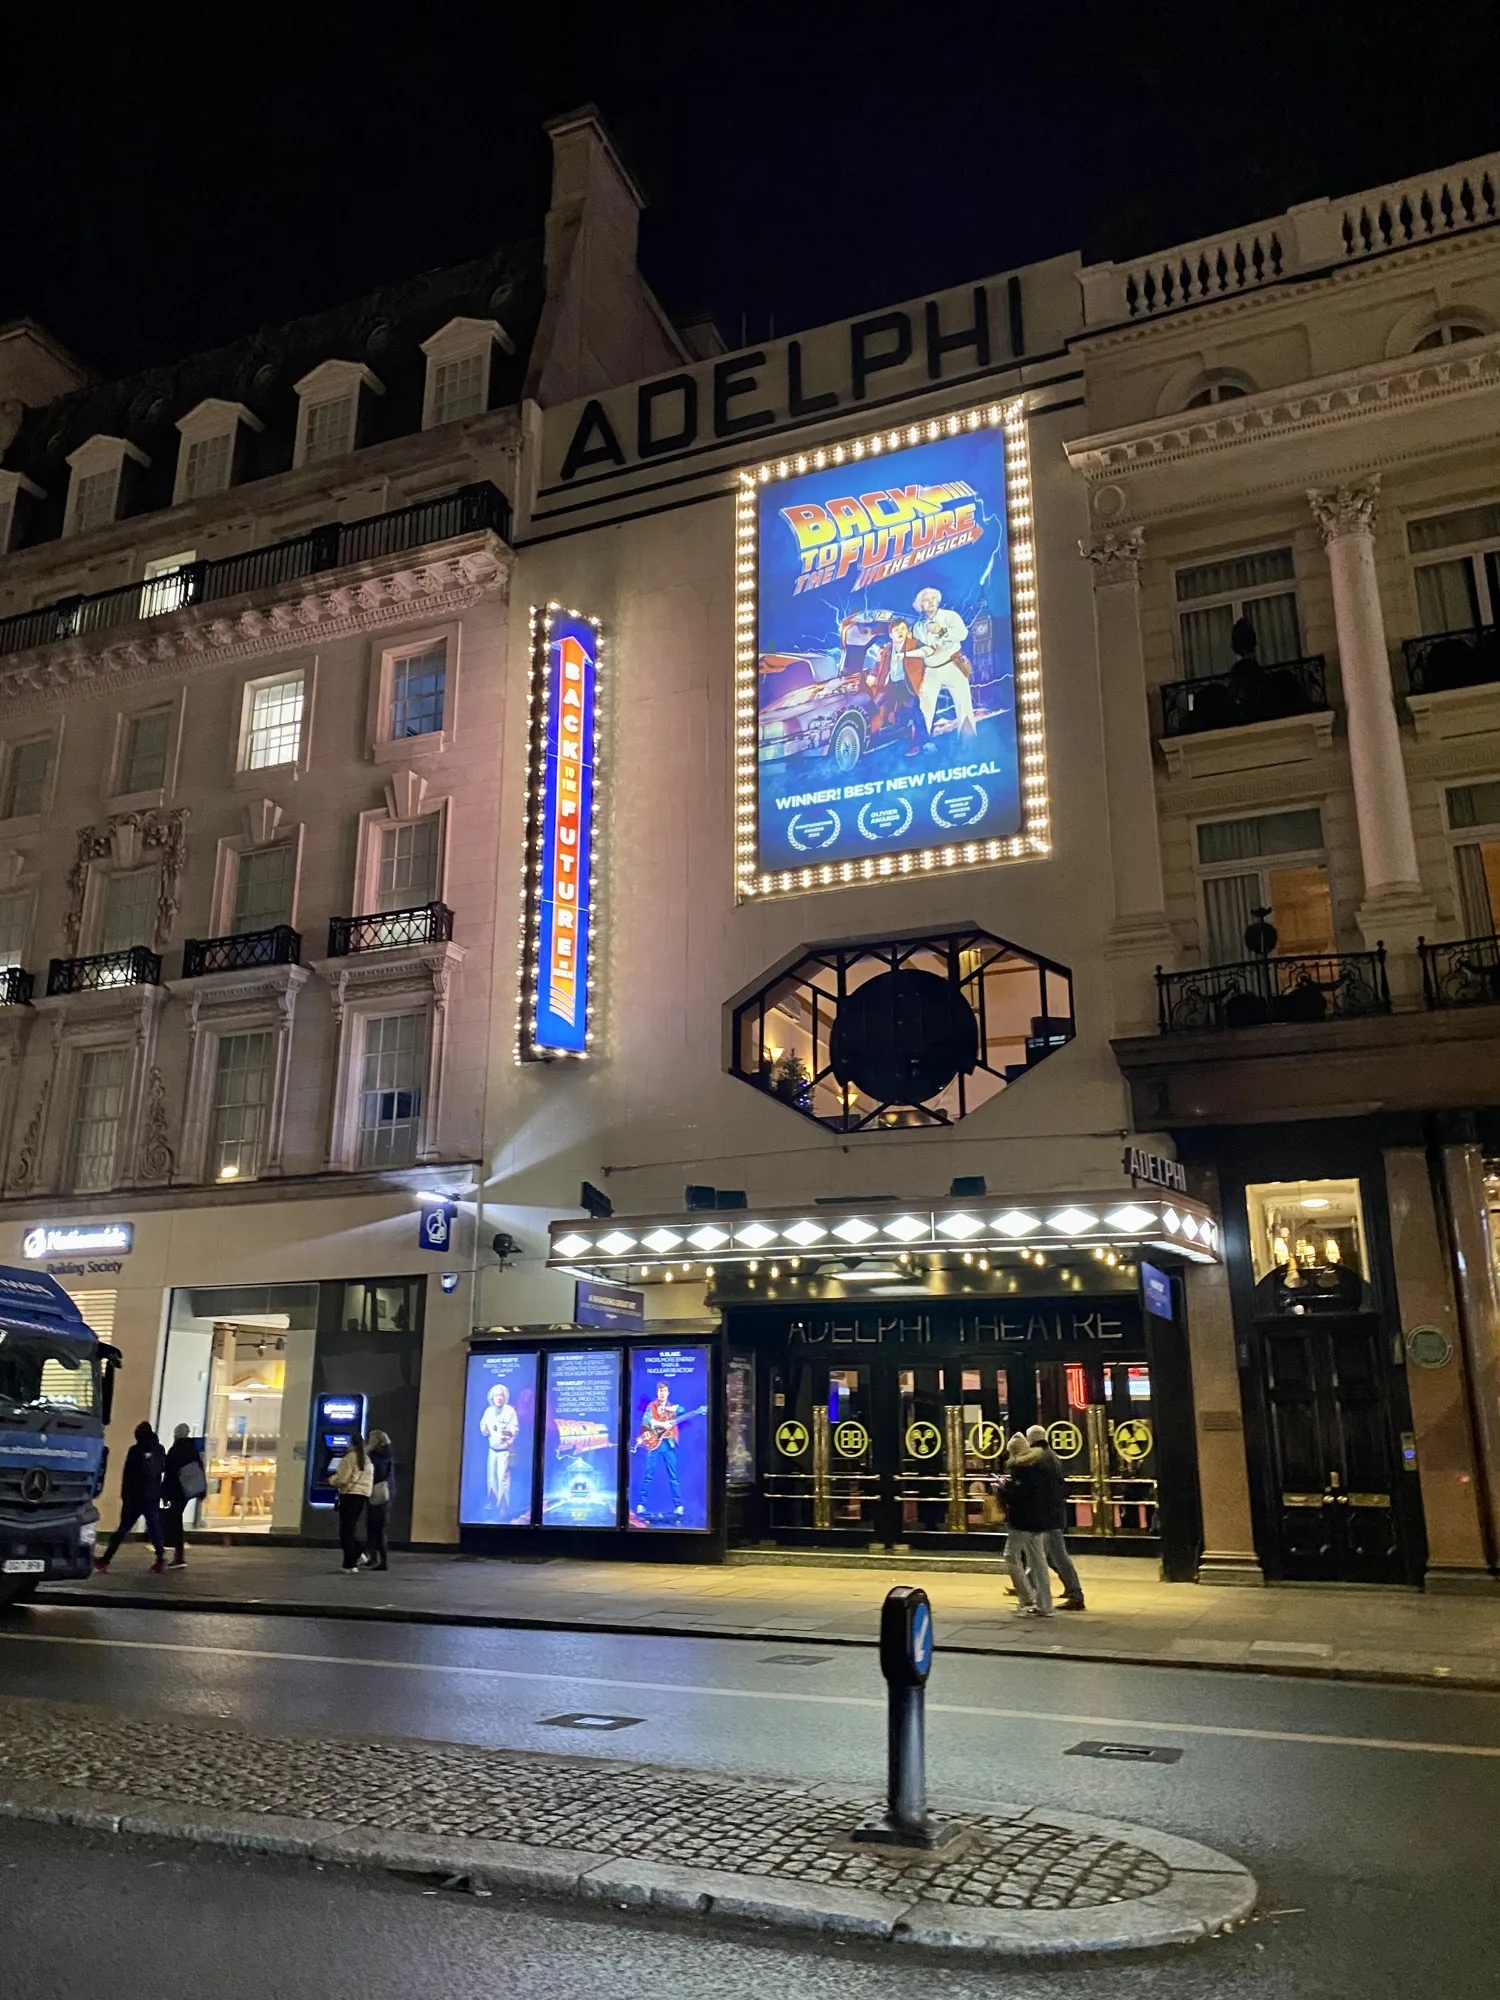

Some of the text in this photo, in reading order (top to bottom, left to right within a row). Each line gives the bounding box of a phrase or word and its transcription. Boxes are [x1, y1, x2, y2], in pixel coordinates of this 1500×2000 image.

[560, 276, 1024, 480] ADELPHI
[780, 484, 942, 549] BACK
[800, 502, 976, 578] TO FUTURE
[882, 529, 975, 576] THE MUSICAL
[793, 565, 837, 596] THE
[775, 761, 1001, 810] WINNER! BEST NEW MUSICAL
[556, 661, 581, 957] BACK TO THE FUTURE
[870, 808, 898, 818] OLIVIER
[870, 814, 901, 825] AWARDS
[1129, 1147, 1187, 1192] ADELPHI
[46, 1227, 127, 1250] Nationwide
[46, 1259, 123, 1276] Building Society
[787, 1315, 931, 1346] ADELPHI
